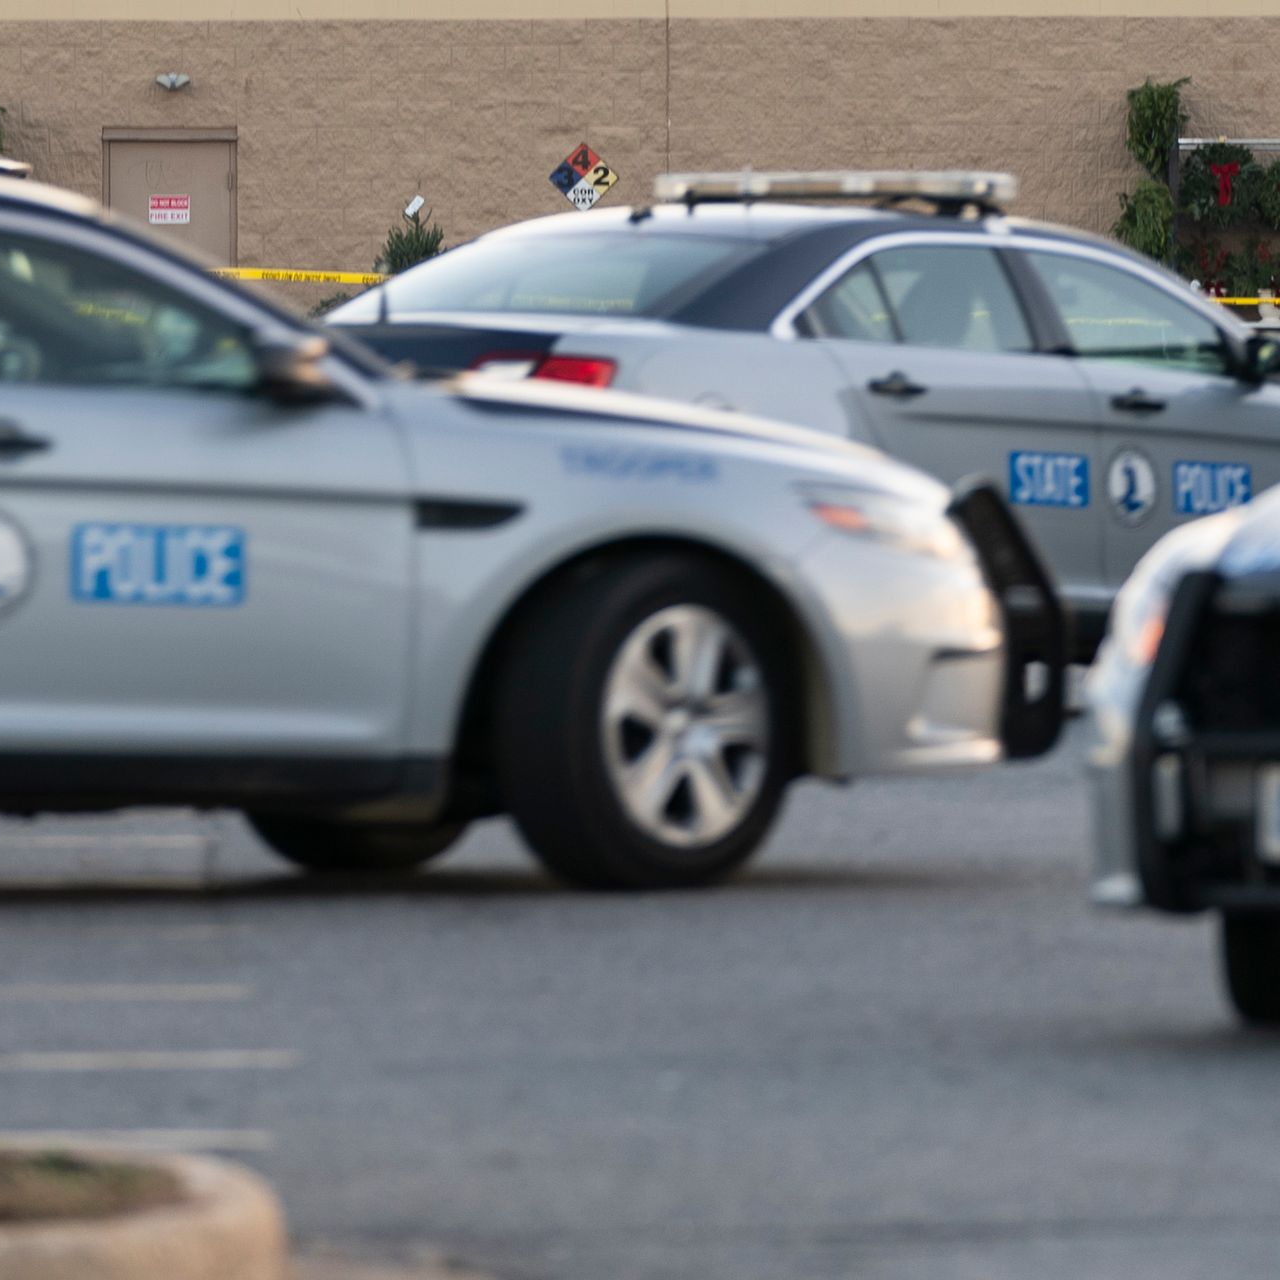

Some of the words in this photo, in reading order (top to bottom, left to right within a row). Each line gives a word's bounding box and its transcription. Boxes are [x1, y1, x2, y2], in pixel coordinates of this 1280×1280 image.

[572, 150, 591, 170] 4
[593, 166, 610, 186] 2
[573, 188, 594, 197] COR
[573, 197, 594, 205] OXY
[150, 212, 168, 221] FIRE
[170, 212, 188, 221] EXIT
[1014, 455, 1083, 504] STATE
[1175, 464, 1247, 512] POLICE
[80, 528, 239, 602] POLICE
